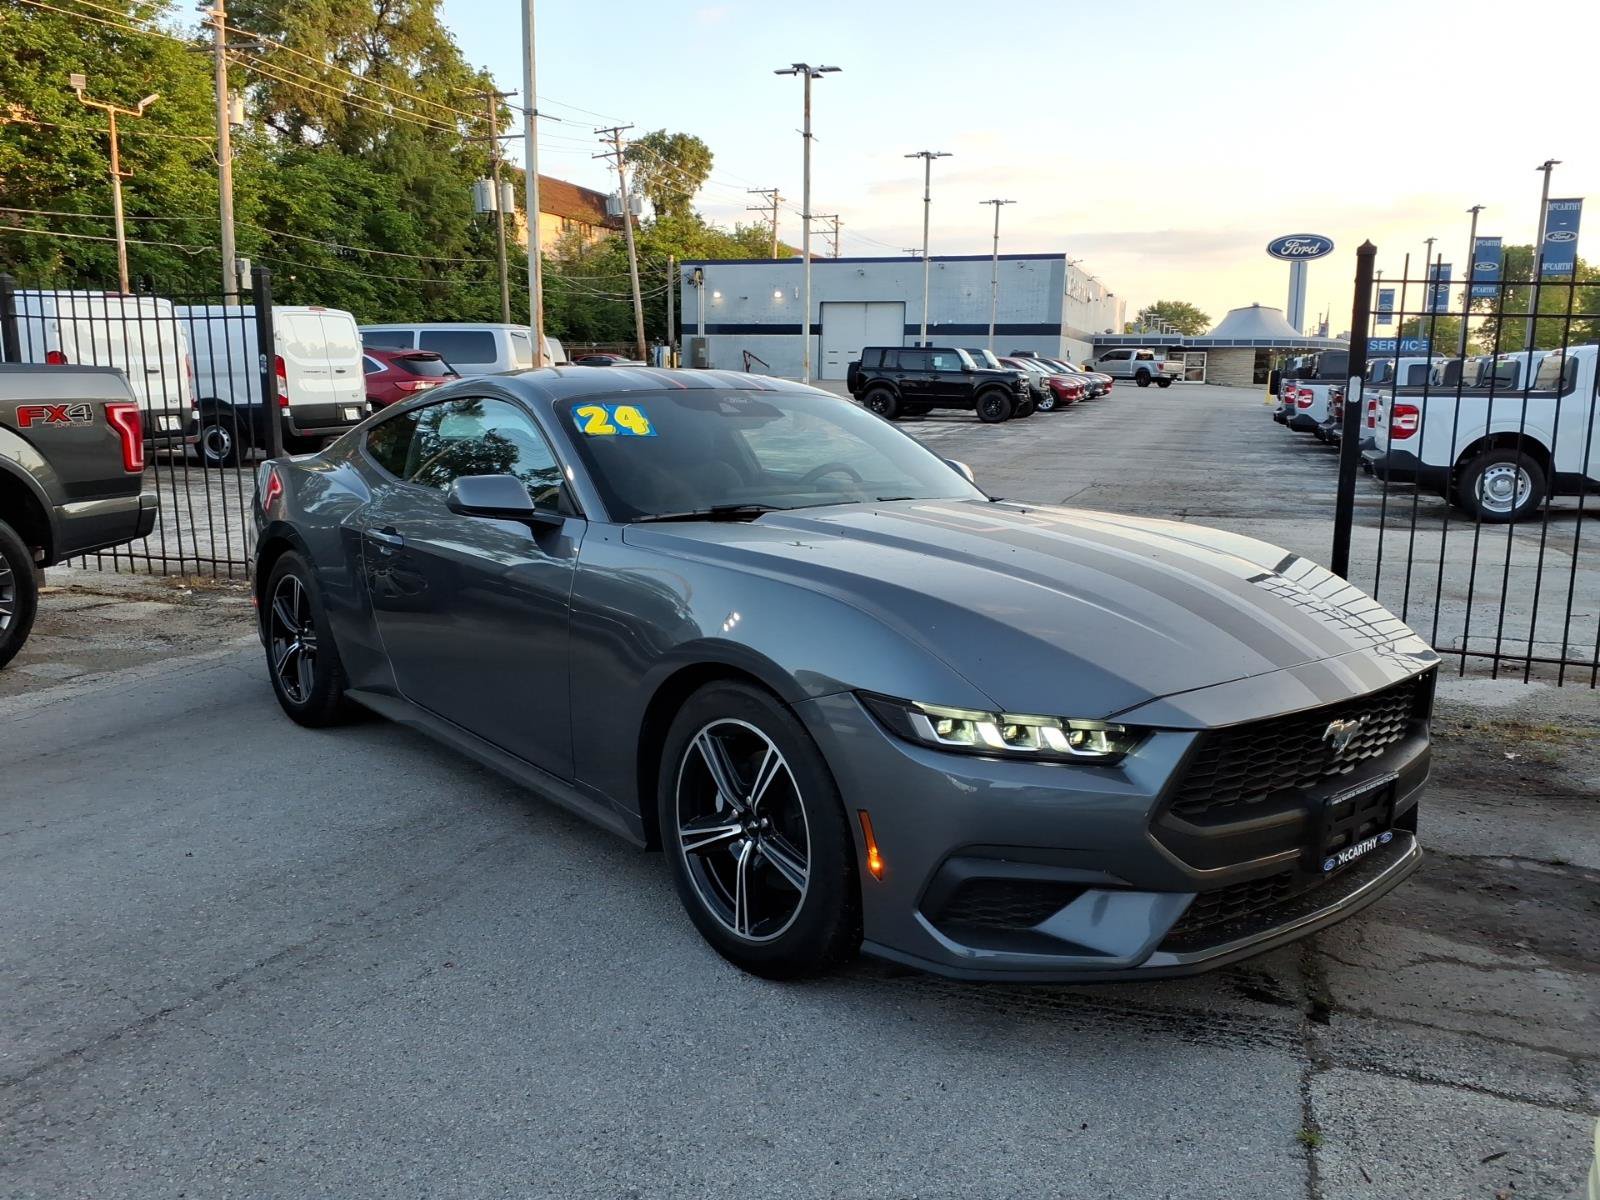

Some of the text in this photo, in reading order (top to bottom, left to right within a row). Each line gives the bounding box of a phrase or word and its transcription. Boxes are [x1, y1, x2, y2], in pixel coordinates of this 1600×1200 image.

[1280, 239, 1321, 255] Ford
[16, 402, 93, 428] FX4
[576, 405, 650, 435] 24
[1338, 836, 1378, 865] McCARTHY
